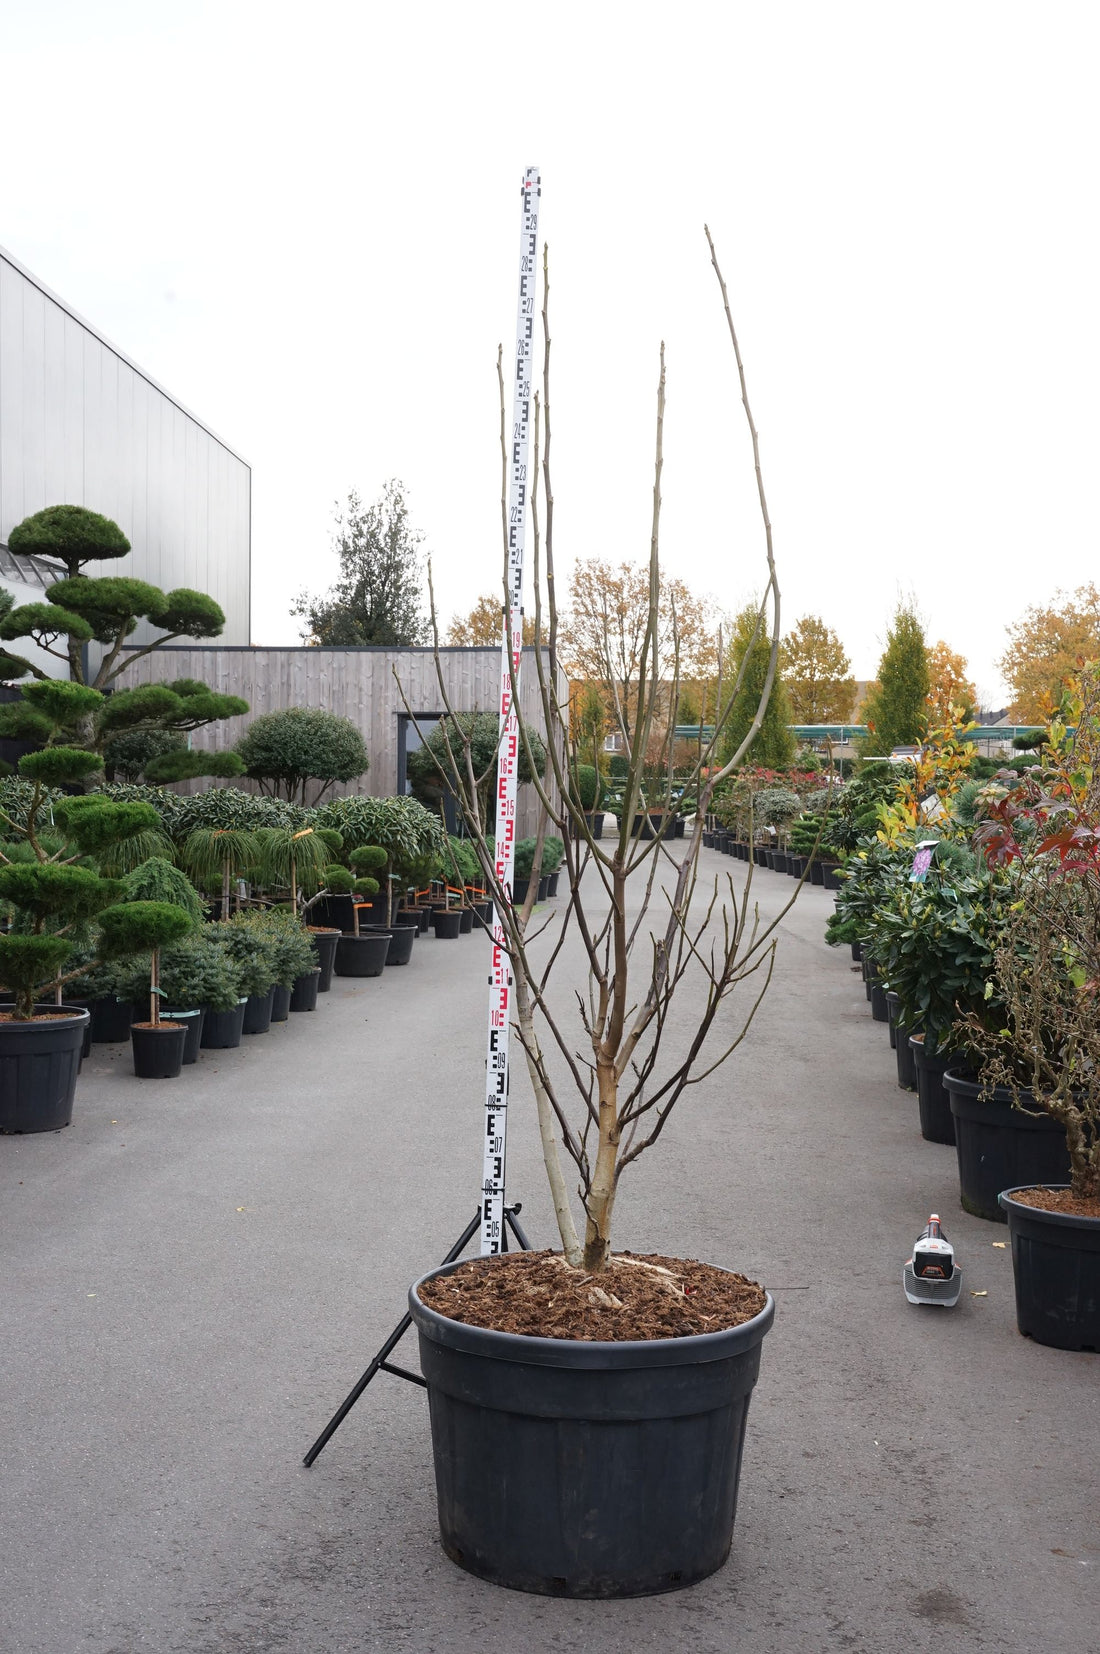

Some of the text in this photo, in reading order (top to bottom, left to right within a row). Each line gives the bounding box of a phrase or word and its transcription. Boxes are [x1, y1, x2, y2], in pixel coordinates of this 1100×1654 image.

[529, 214, 537, 230] 29
[526, 298, 534, 314] 27
[514, 423, 521, 439] 24
[519, 465, 526, 480] 23
[510, 506, 518, 522] 22
[515, 548, 523, 564] 21
[512, 632, 520, 648] 19
[503, 673, 511, 690] 18
[510, 715, 518, 731] 17
[500, 758, 507, 774] 16
[506, 800, 514, 816] 15
[497, 842, 504, 858] 14
[494, 926, 502, 942] 12
[501, 968, 509, 984] 11
[491, 1010, 499, 1026] 10
[498, 1053, 505, 1069] 09
[488, 1095, 496, 1111] 08
[494, 1137, 502, 1153] 07
[485, 1179, 493, 1195] 06
[491, 1221, 499, 1237] 05
